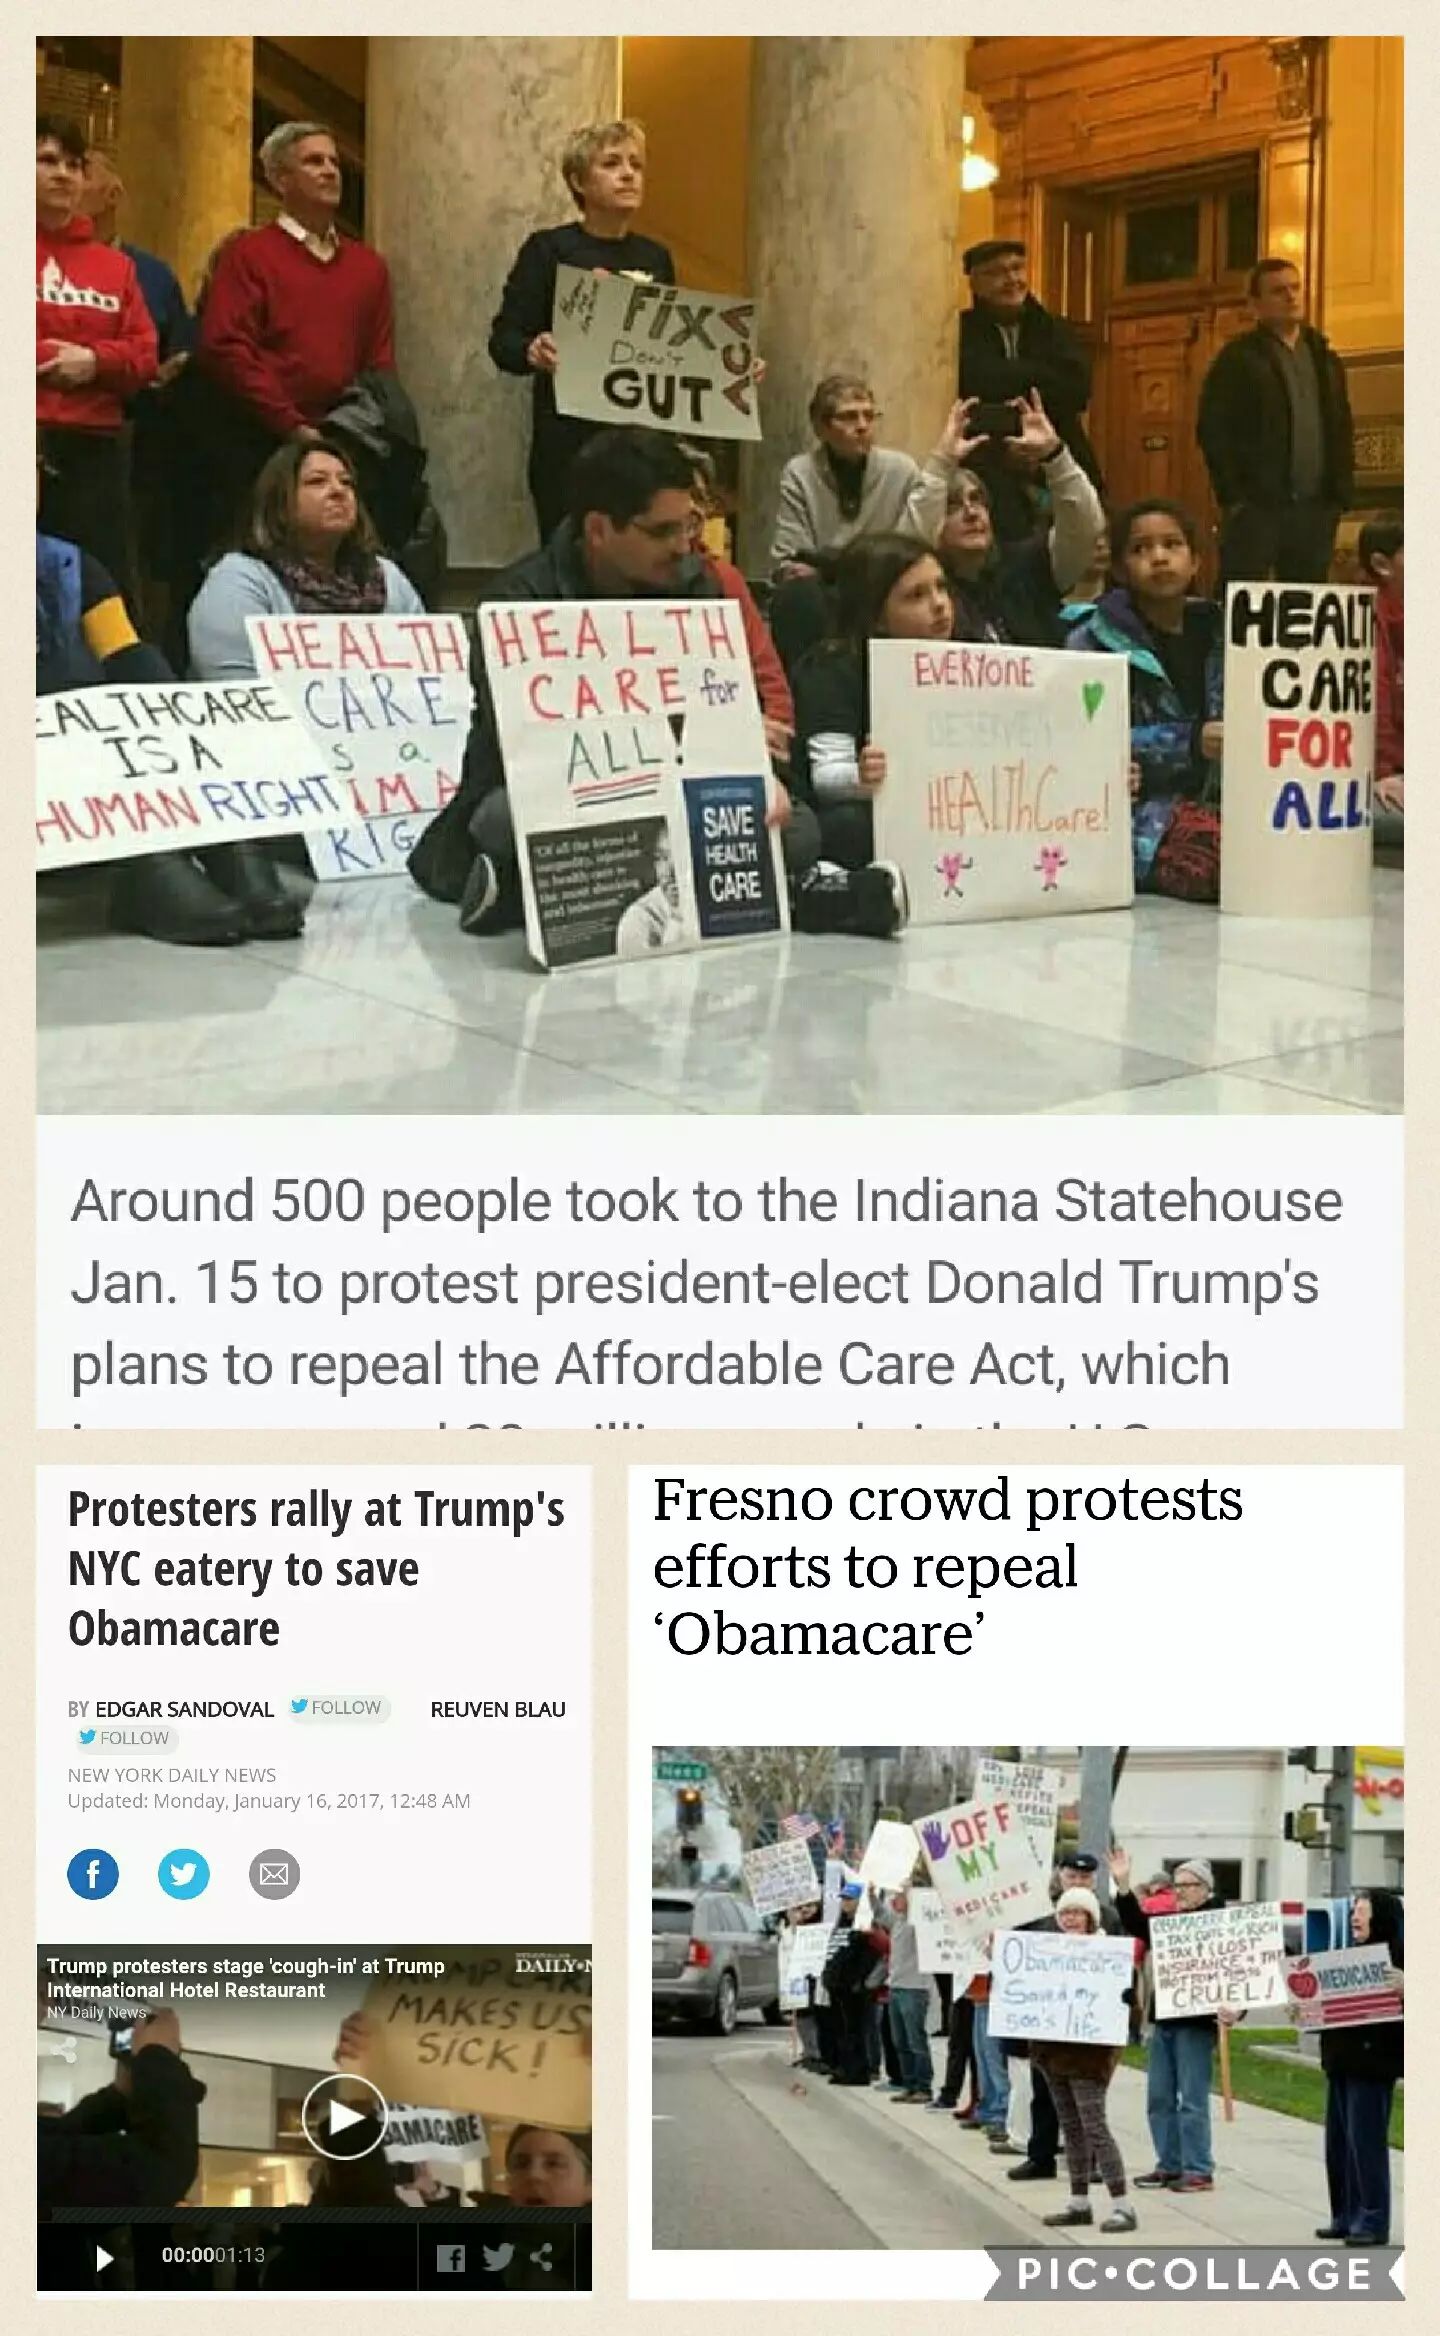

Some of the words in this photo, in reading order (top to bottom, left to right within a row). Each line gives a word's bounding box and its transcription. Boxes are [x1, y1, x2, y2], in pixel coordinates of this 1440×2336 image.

[604, 368, 713, 422] GUT
[258, 620, 466, 672] HEALTH
[489, 607, 737, 669] HEALTH
[305, 675, 457, 732] CARE
[529, 667, 686, 719] CARE
[701, 668, 738, 706] for
[1262, 658, 1371, 713] CARE
[103, 735, 178, 777] IS
[187, 735, 223, 772] A
[1267, 718, 1352, 768] FOR
[36, 786, 201, 845] HUMAN
[201, 774, 342, 820] RIGHT
[704, 805, 754, 838] SAVE
[1272, 769, 1370, 831] ALL!
[706, 842, 758, 865] HEALTH
[710, 870, 762, 902] CARE
[952, 1802, 1010, 1848] OFF
[956, 1841, 1000, 1883] MY
[1003, 1937, 1127, 1977] Obamacare
[1317, 1962, 1388, 1990] MEDICARE
[388, 1993, 520, 2030] MAKES
[531, 2001, 592, 2035] US
